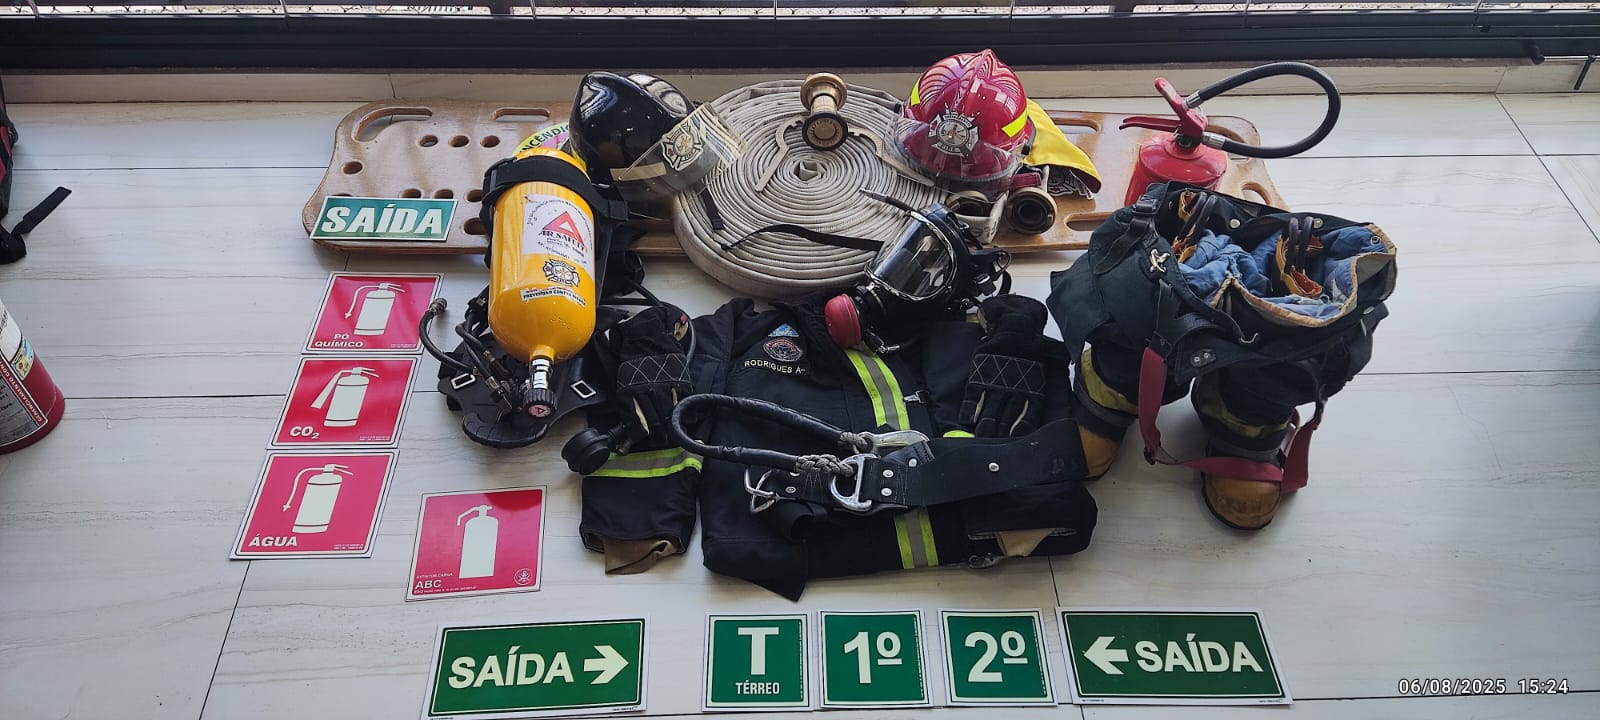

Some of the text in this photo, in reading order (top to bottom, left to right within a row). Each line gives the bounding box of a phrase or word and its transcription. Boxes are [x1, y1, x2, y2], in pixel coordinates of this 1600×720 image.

[520, 124, 570, 152] NCÊNDI
[321, 203, 442, 234] SAÍDA
[744, 359, 793, 374] RODRIGUES
[248, 533, 297, 547] ÁGUA
[415, 580, 442, 589] ABC
[448, 645, 575, 689] SAÍDA
[737, 627, 780, 676] T
[843, 631, 902, 684] 1º
[964, 630, 1028, 683] 2º
[1135, 633, 1264, 672] SAÍDA
[735, 680, 780, 695] TÉRREO
